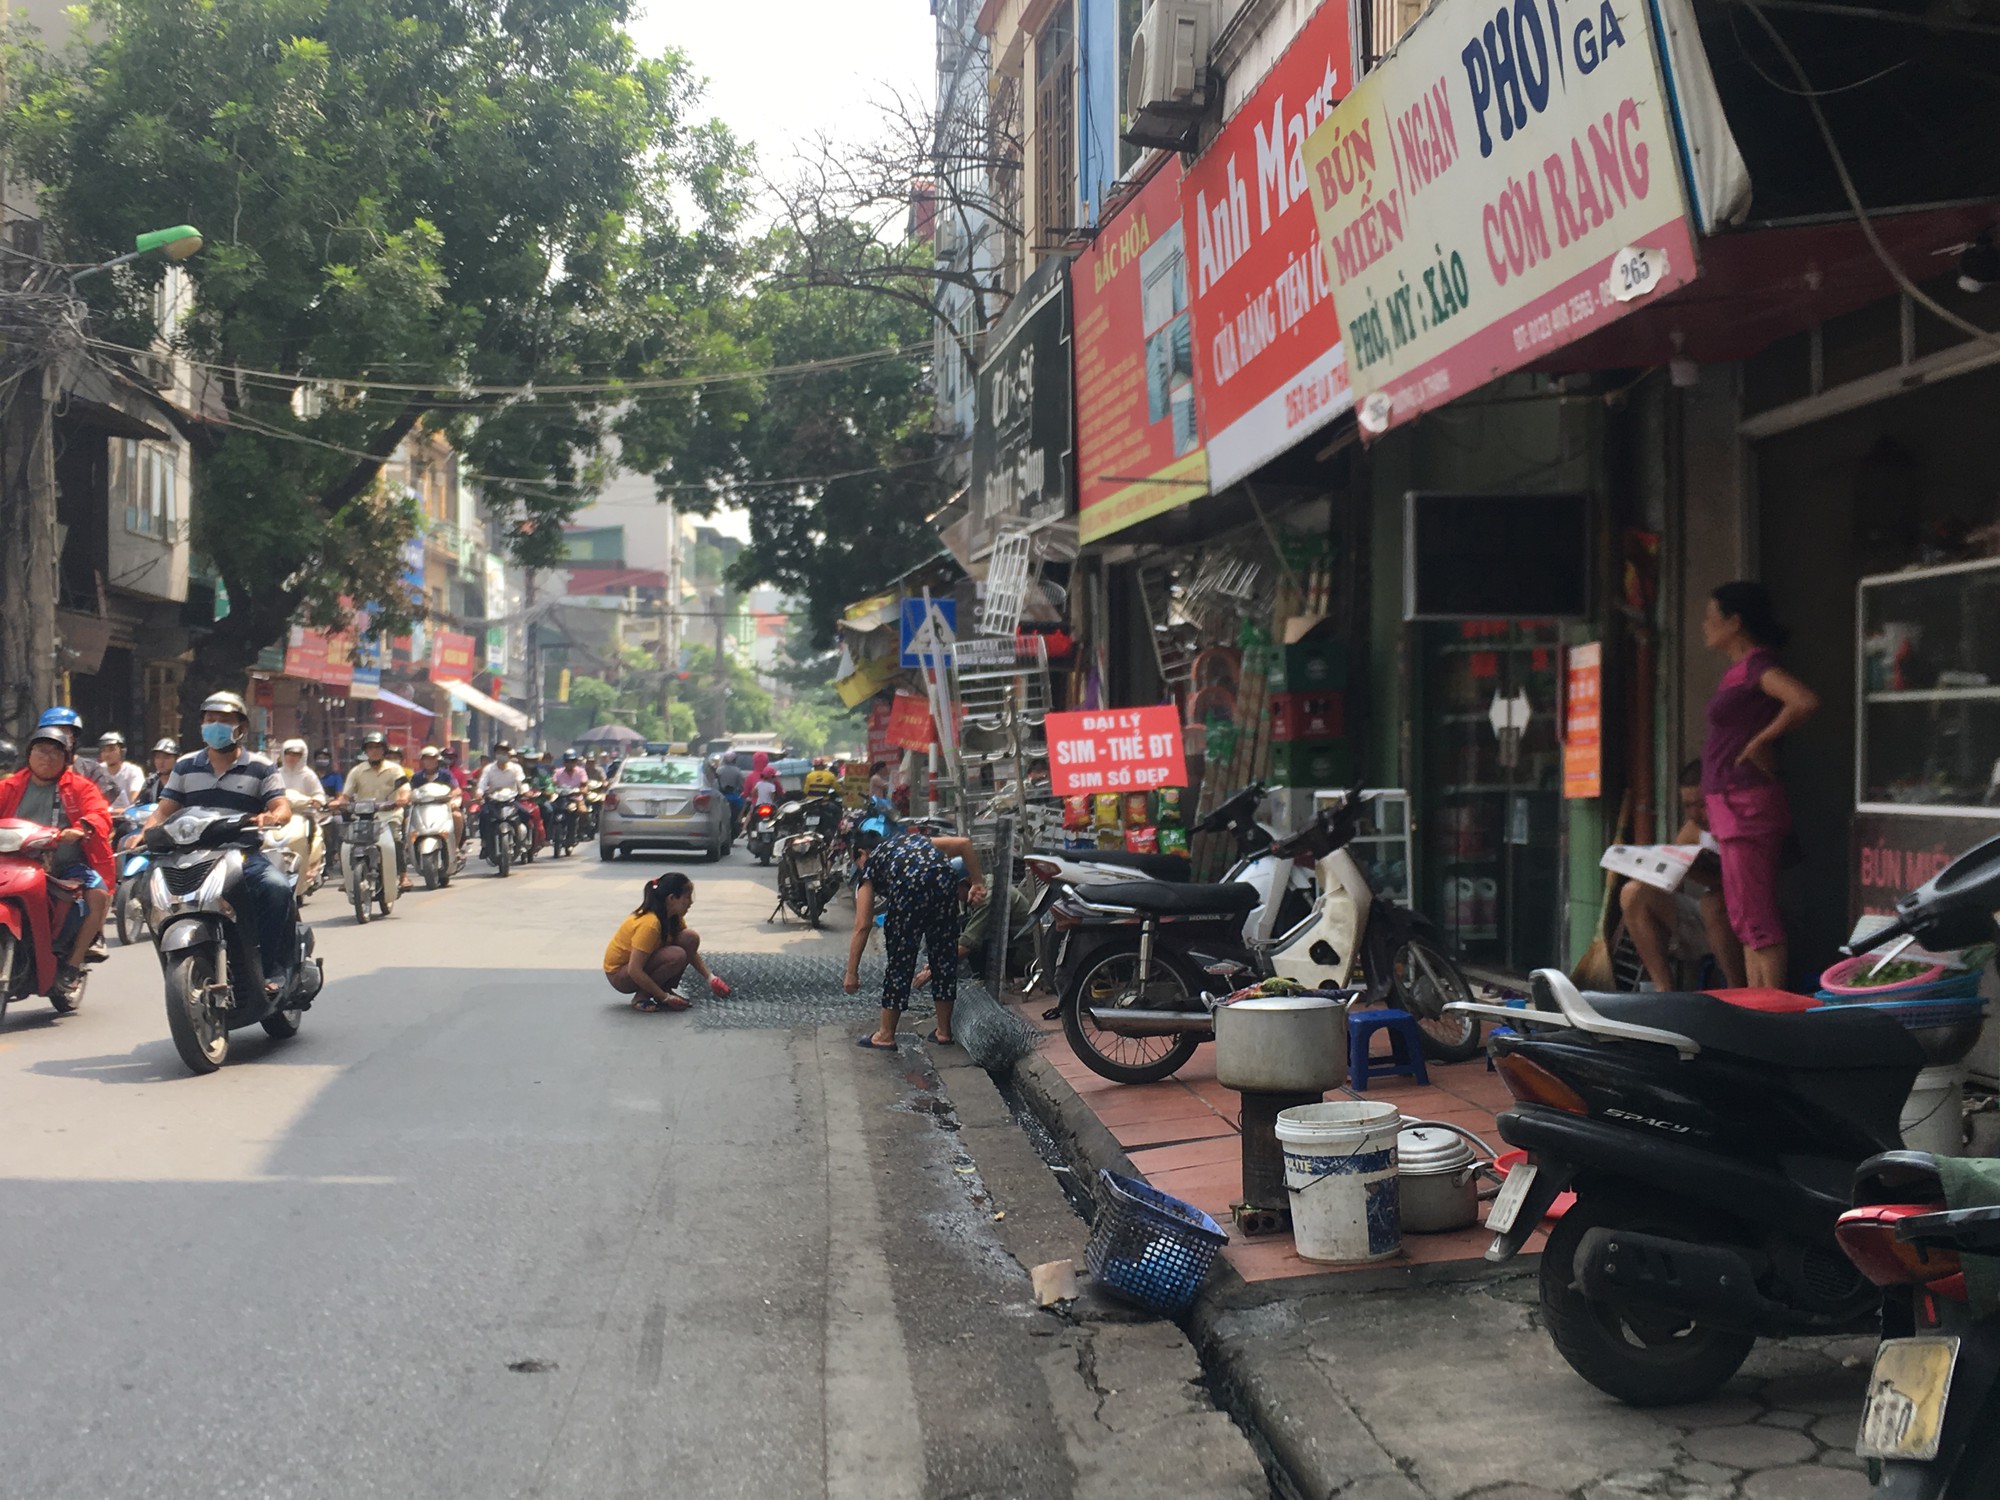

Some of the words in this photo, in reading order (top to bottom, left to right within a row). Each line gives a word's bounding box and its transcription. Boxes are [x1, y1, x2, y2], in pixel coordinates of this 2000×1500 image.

[1196, 152, 1251, 299] Anh
[1254, 54, 1338, 236] Mart
[1316, 117, 1375, 212] BÚN
[1398, 75, 1459, 196] NGAN
[1332, 179, 1403, 286] MIẾN
[1482, 170, 1551, 286] CƠM
[1543, 97, 1649, 248] RANG
[1236, 286, 1276, 368] HÀNG
[1275, 251, 1310, 336] TIỆN
[1621, 251, 1650, 291] 265
[1056, 739, 1096, 764] SIM
[1107, 728, 1145, 761] THẺ
[1148, 733, 1173, 758] ĐT
[1082, 715, 1114, 732] ĐẠI
[1068, 772, 1102, 788] SIM
[1107, 765, 1131, 785] SỐ
[1135, 767, 1169, 786] ĐẸP
[1603, 1108, 1690, 1133] SPACY
